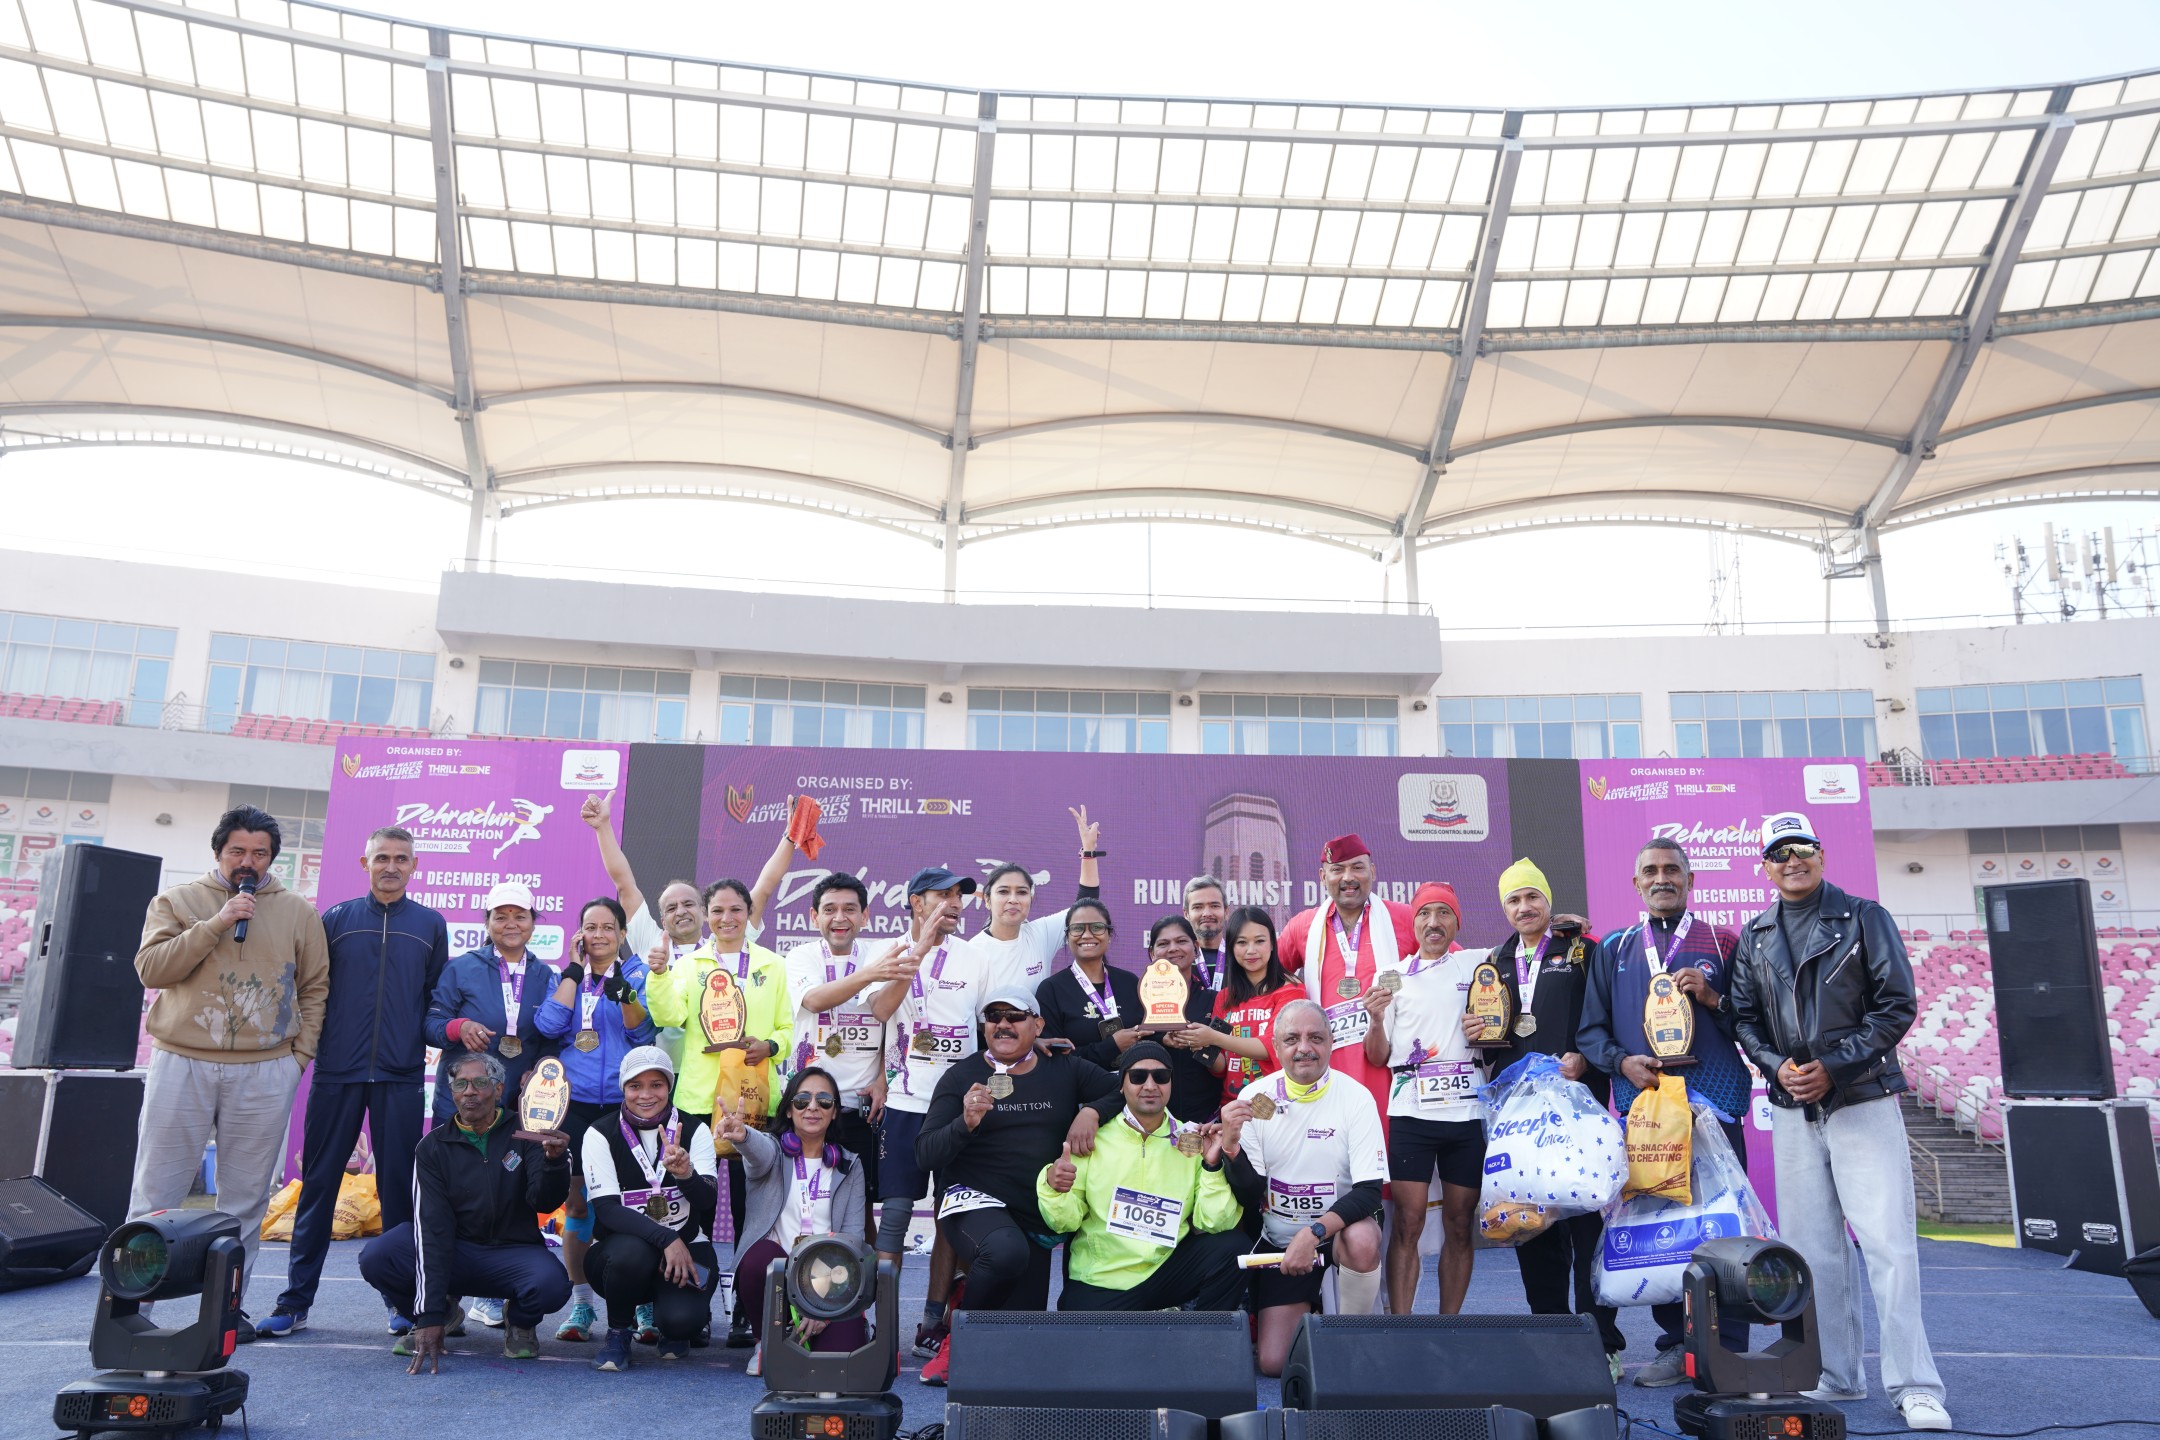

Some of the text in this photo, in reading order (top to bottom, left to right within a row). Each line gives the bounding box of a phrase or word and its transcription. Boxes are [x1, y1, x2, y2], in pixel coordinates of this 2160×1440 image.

[386, 746, 462, 757] ORGANISED BY:
[380, 762, 396, 770] AIR
[396, 760, 424, 768] WATER
[428, 764, 458, 774] THRILL
[1630, 767, 1705, 776] ORGANISED BY:
[354, 766, 423, 779] ADVENTURES
[796, 776, 913, 790] ORGANISED BY:
[1643, 780, 1669, 788] WATER
[1674, 784, 1703, 793] THRILL
[1604, 786, 1669, 800] ADVENTURES
[753, 802, 785, 812] LAND
[859, 798, 914, 814] THRILL
[394, 801, 516, 829] Dehradun
[818, 815, 848, 825] GLOBAL
[431, 828, 504, 840] MARATHON
[414, 842, 440, 850] DITION
[1690, 847, 1761, 857] MARATHON
[426, 871, 500, 887] DECEMBER
[505, 873, 542, 888] 2025
[1134, 879, 1182, 905] RUN
[1693, 888, 1765, 904] DECEMBER
[776, 913, 821, 932] HAL
[453, 929, 560, 949] SBI EAP
[1665, 936, 1681, 958] DEC 2025
[1229, 1008, 1273, 1024] BUT FIRS
[1330, 1012, 1369, 1034] 2274
[840, 1027, 869, 1042] 193
[931, 1039, 962, 1053] 293
[1428, 1075, 1470, 1092] 2345
[1500, 1156, 1506, 1167] 2
[1637, 1153, 1682, 1163] CHEATING
[636, 1201, 681, 1216] 29
[1279, 1195, 1324, 1210] 2185
[1123, 1204, 1167, 1228] 1065
